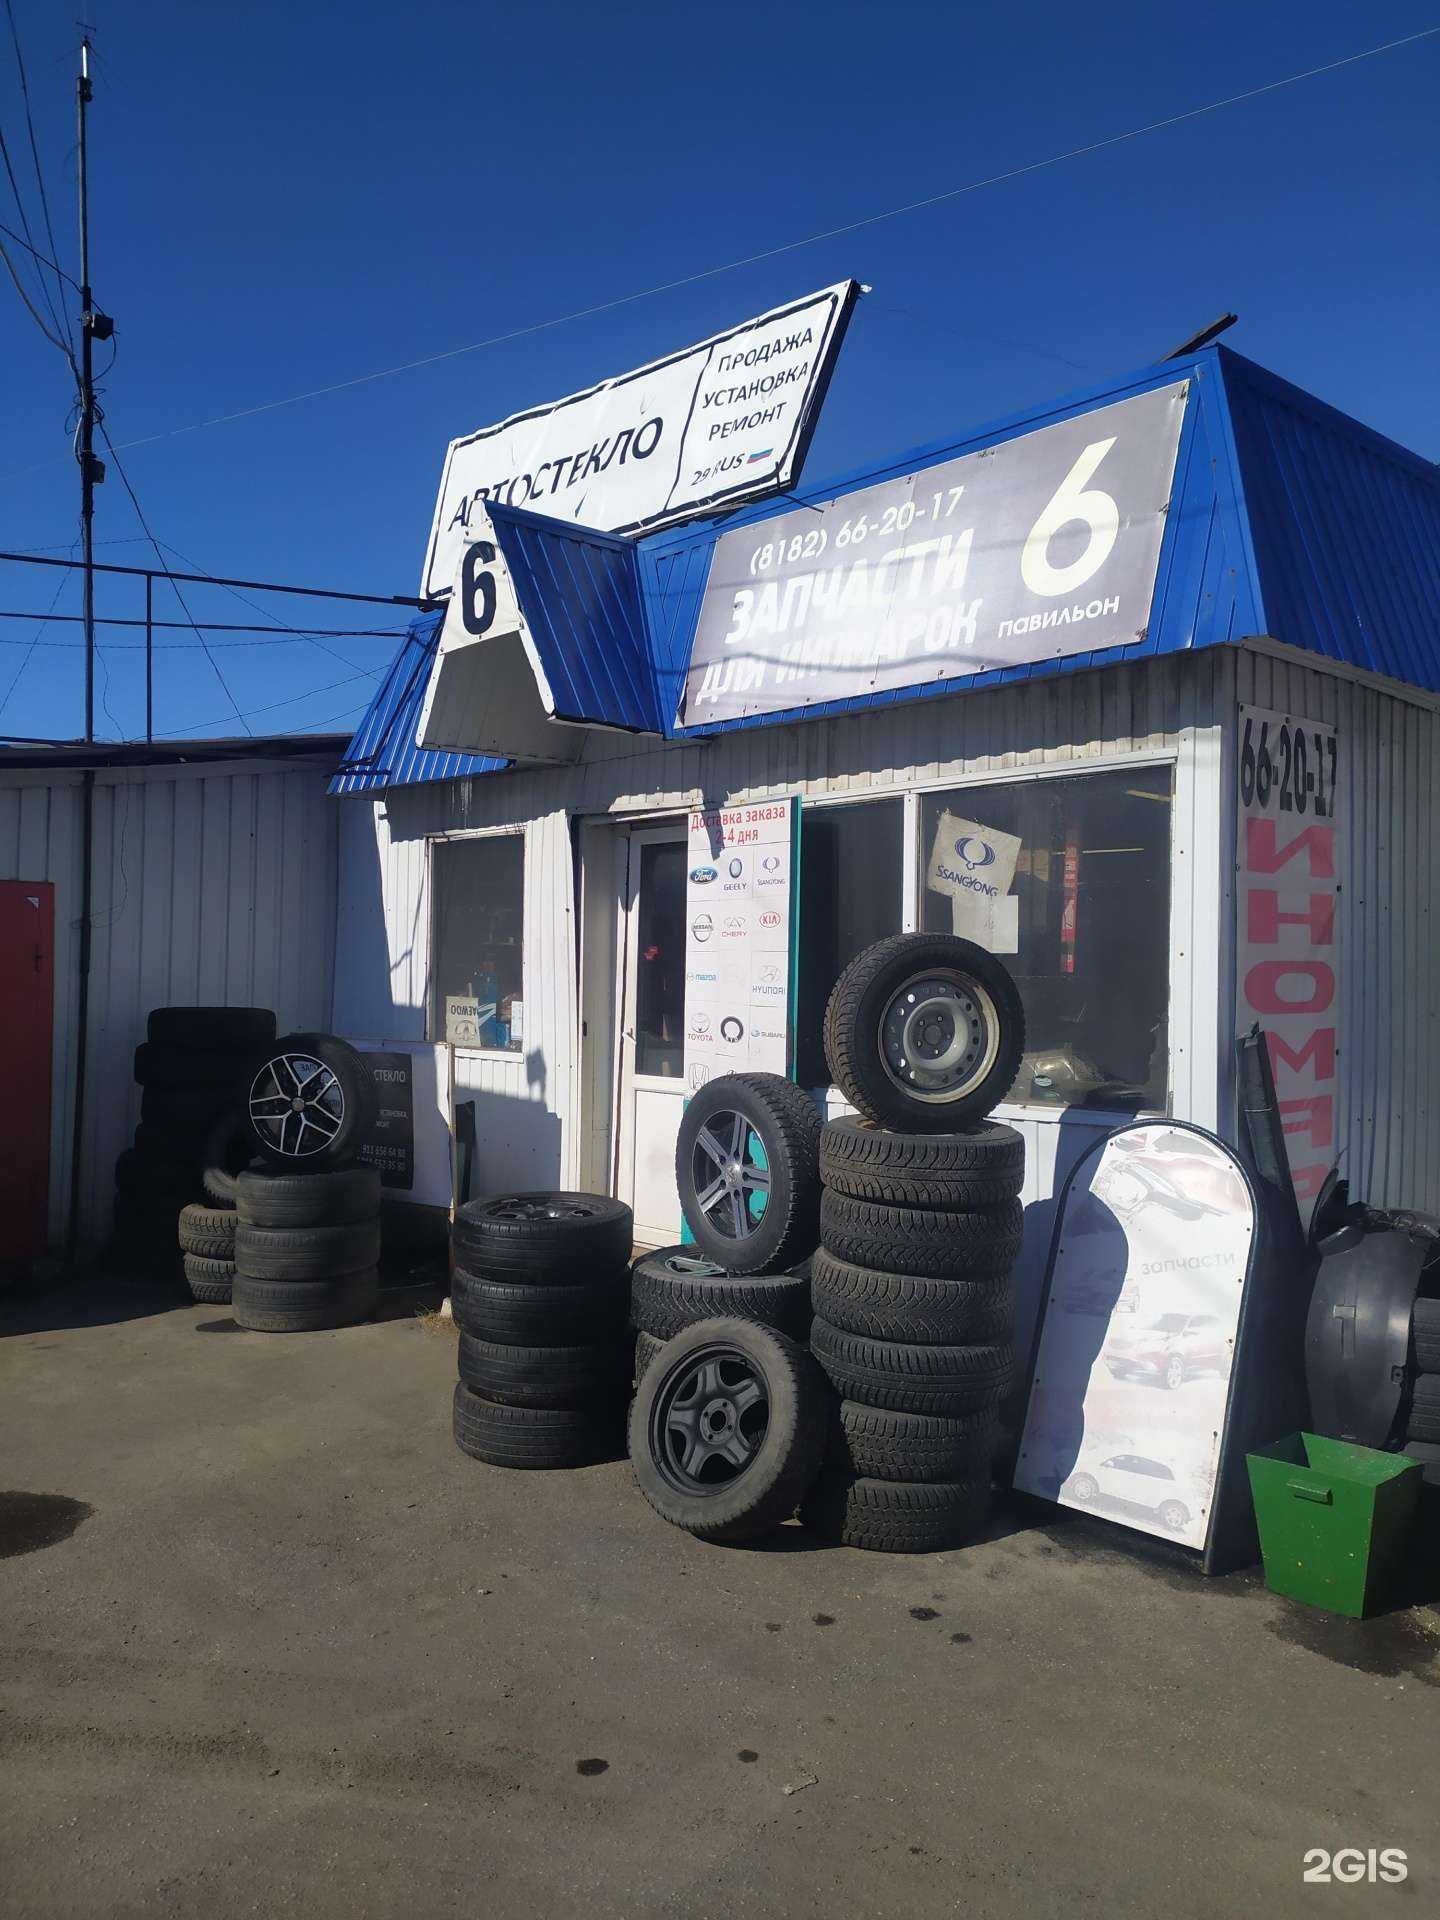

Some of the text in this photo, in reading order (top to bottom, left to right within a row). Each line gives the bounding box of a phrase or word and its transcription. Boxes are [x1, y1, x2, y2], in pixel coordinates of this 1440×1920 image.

[717, 327, 813, 373] ПРОДАЖА
[702, 361, 809, 409] УСТАНОВКА
[708, 401, 788, 441] РЕМОНТ
[750, 485, 965, 576] (8182) 66-20-17
[1020, 437, 1120, 597] 6
[461, 540, 497, 636] 6
[724, 528, 974, 644] ЗАПЧАСТИ
[1240, 718, 1338, 818] 66-20-17
[691, 806, 786, 833] Доставка заказа
[737, 829, 759, 844] дня
[694, 869, 714, 882] Ford
[723, 883, 748, 891] GEELY
[935, 864, 1000, 897] SSANGYONG
[720, 930, 748, 938] CHERY
[762, 914, 779, 925] KIA
[752, 985, 786, 996] HYUNDAI
[687, 1033, 714, 1043] TOYOTA
[1141, 1252, 1235, 1276] запчасти
